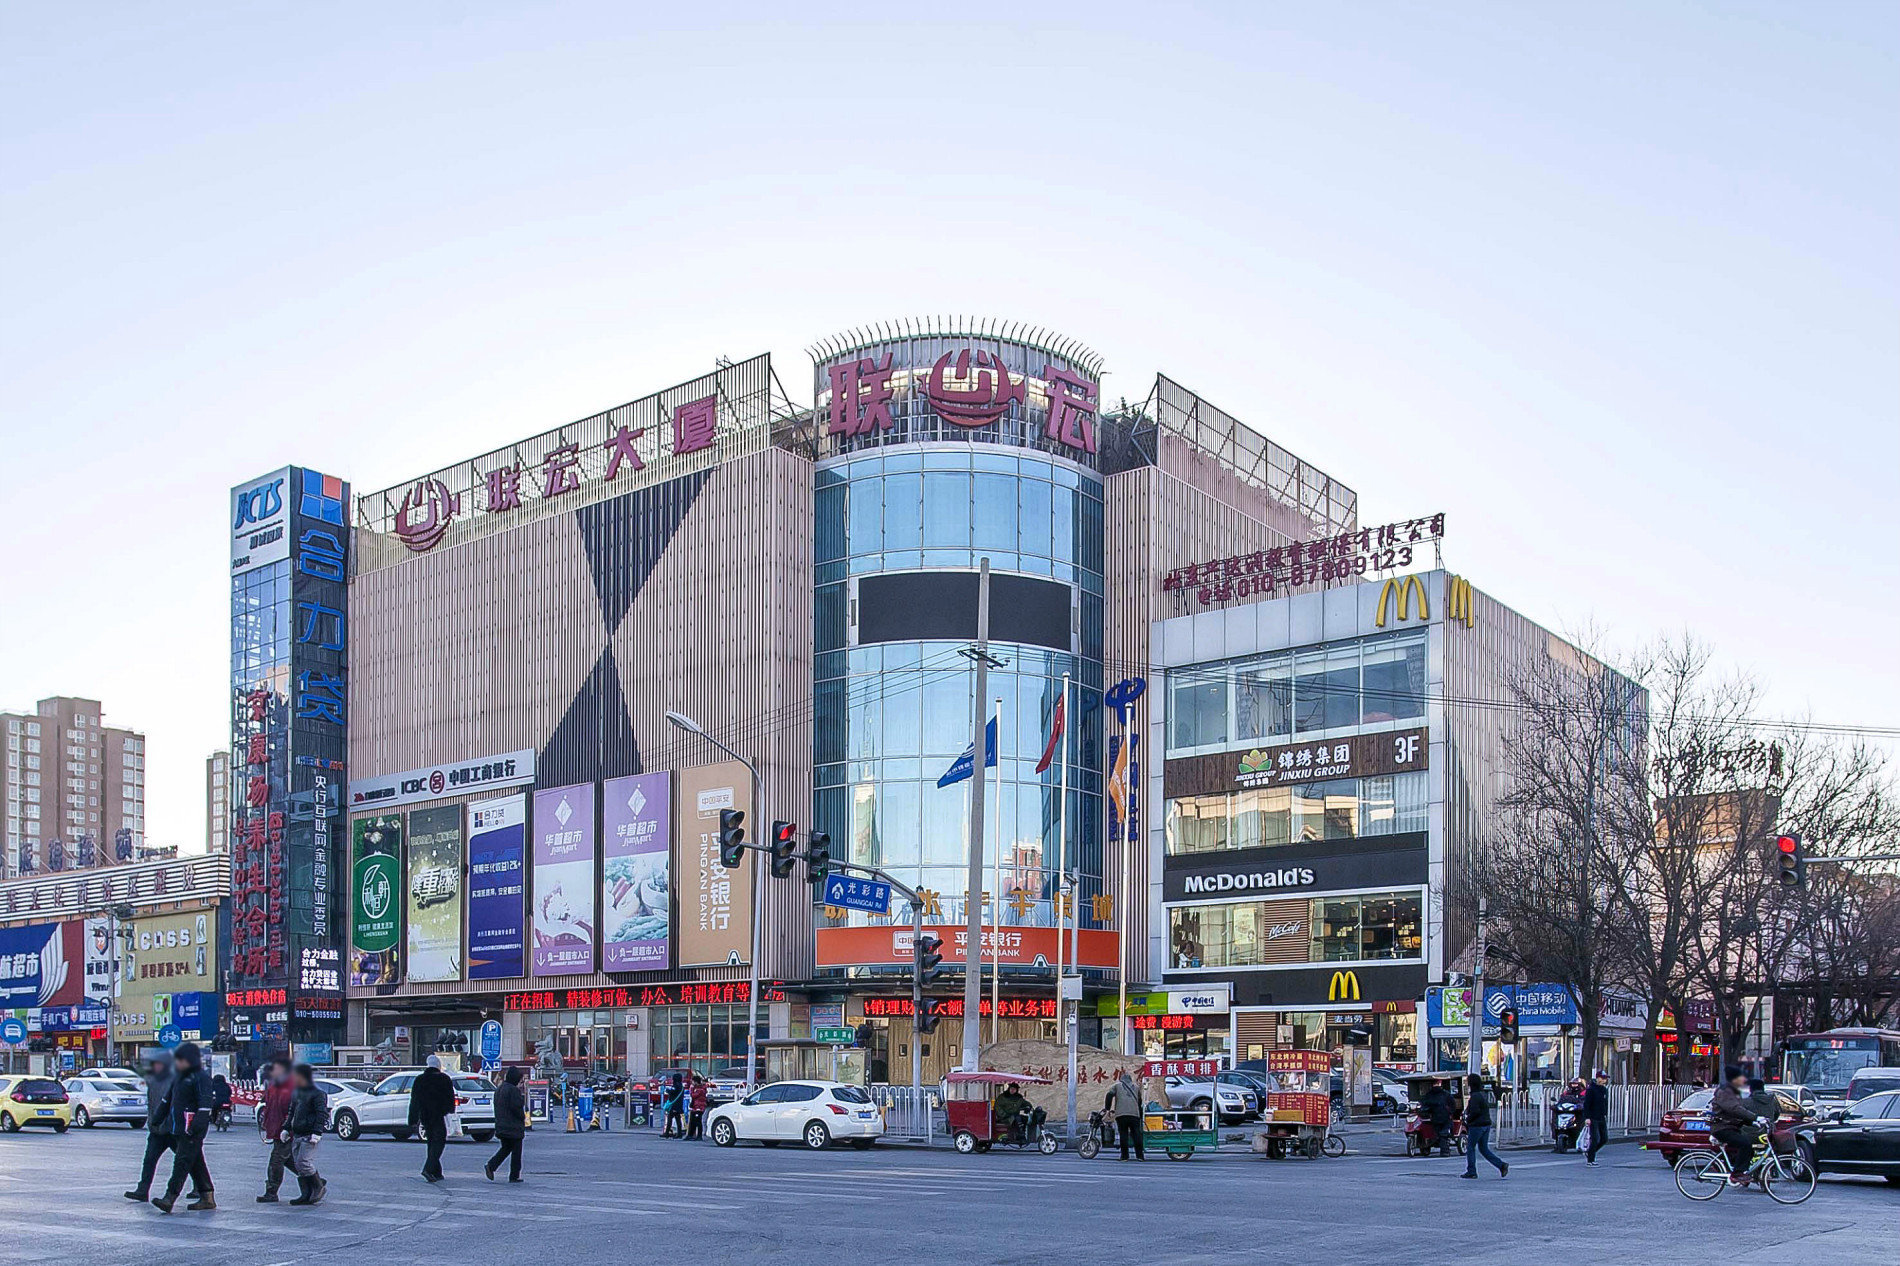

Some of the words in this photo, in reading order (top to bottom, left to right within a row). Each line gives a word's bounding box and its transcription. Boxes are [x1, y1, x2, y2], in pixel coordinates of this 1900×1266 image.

[828, 352, 894, 439] 联
[1044, 364, 1098, 454] 宏
[486, 394, 718, 513] 联宏大厦
[1278, 744, 1350, 769] 锦绣集团
[1394, 735, 1420, 764] 3F
[449, 759, 516, 786] 中国工商银行
[1278, 769, 1312, 781] JINXIU
[1313, 765, 1351, 777] GROUP
[401, 777, 427, 795] ICBC
[847, 882, 884, 899] 光彩路
[1184, 867, 1315, 894] McDonald's
[700, 894, 708, 931] BANK
[846, 897, 873, 907] GUANGCAI
[504, 980, 750, 1010] 正在招租，精装修可做：办公、培训教育等
[1516, 992, 1566, 1006] 中国移动
[864, 998, 1057, 1017] 销理财、大额单等业务请
[1134, 1015, 1157, 1029] 途费
[1162, 1015, 1194, 1029] 漫游费
[1150, 1062, 1212, 1076] 香酥鸡排
